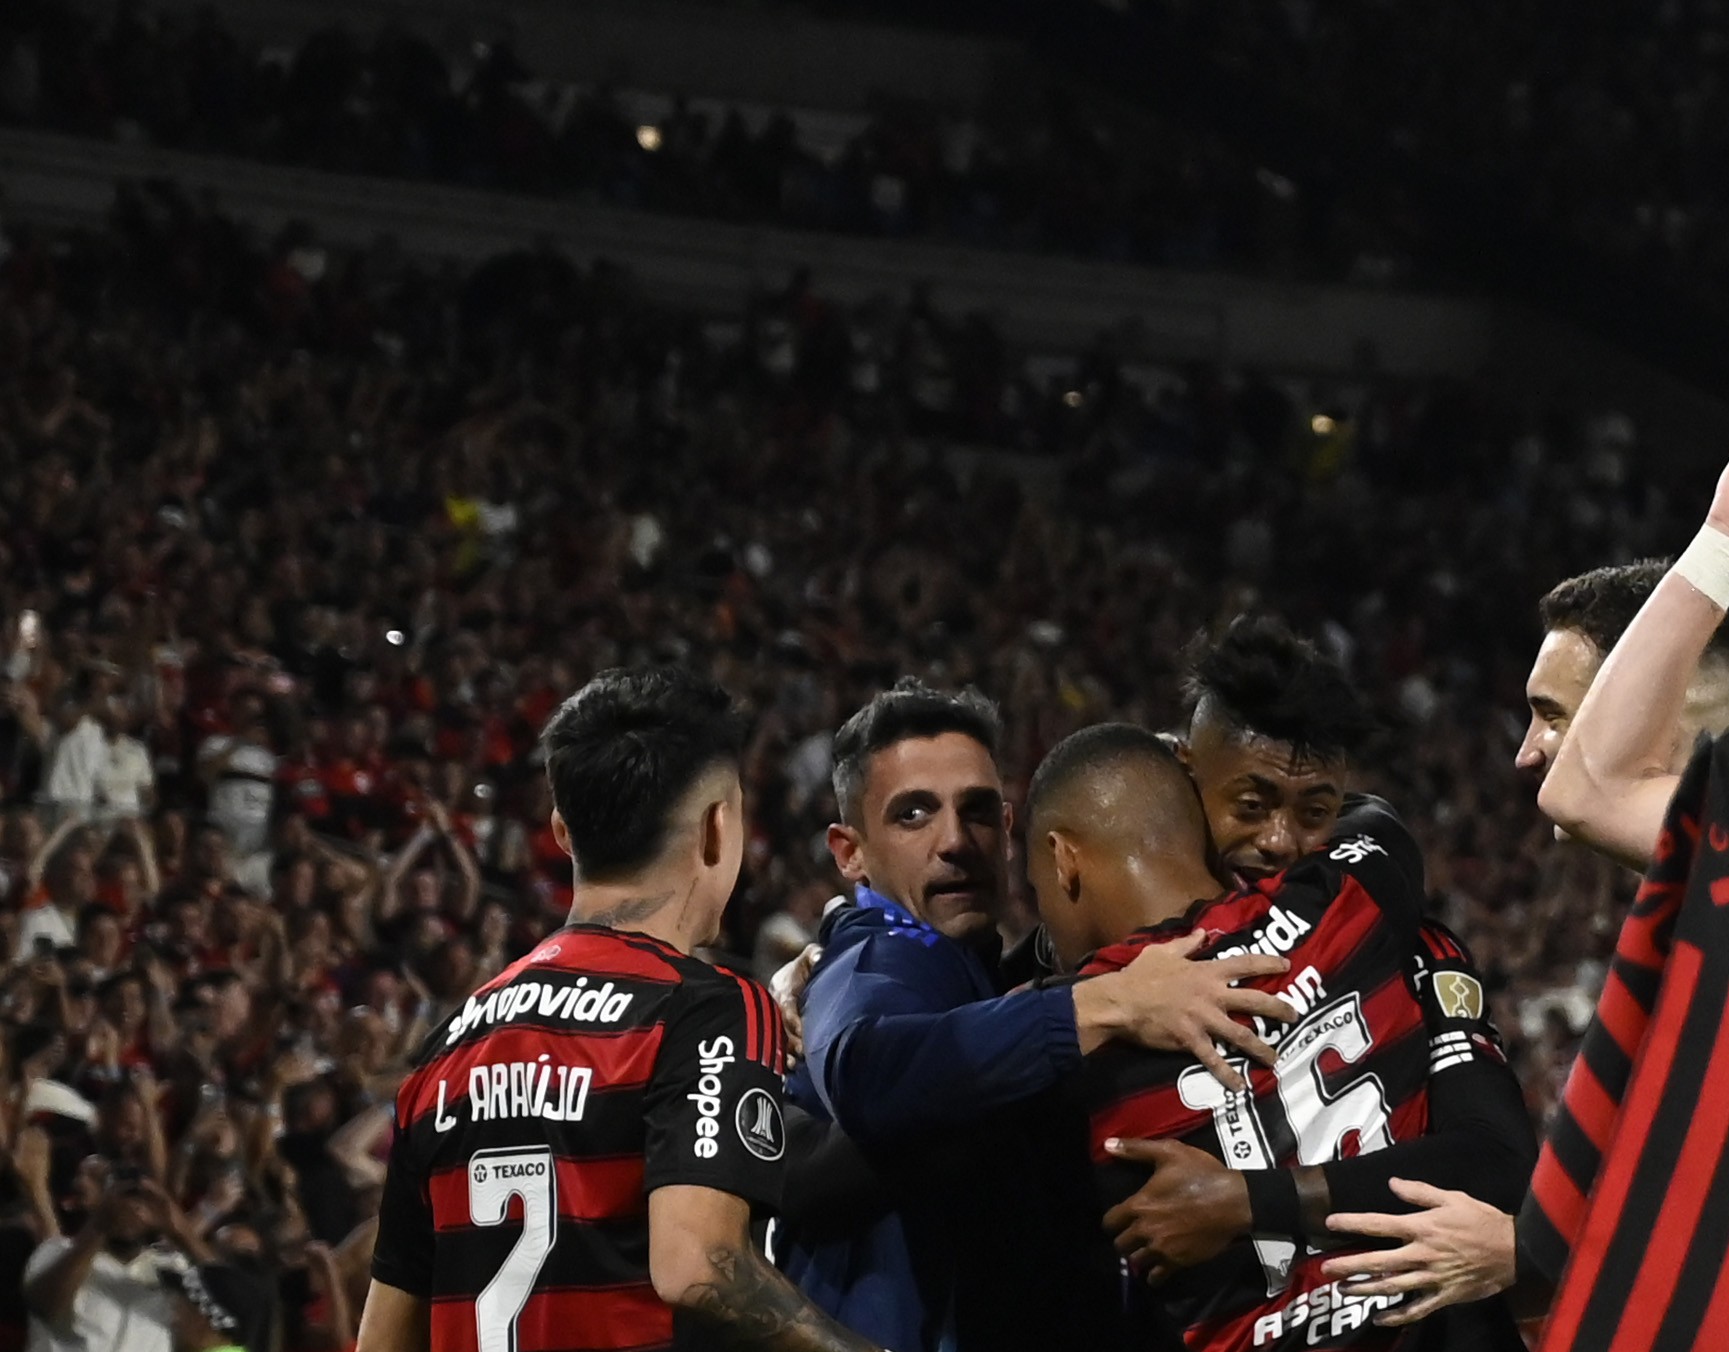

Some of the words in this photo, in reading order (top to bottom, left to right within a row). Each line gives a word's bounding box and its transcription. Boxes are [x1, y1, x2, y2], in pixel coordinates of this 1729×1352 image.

[468, 1053, 593, 1122] ARAÚJO
[687, 1035, 735, 1158] Shopee
[492, 1161, 546, 1180] TEXACO
